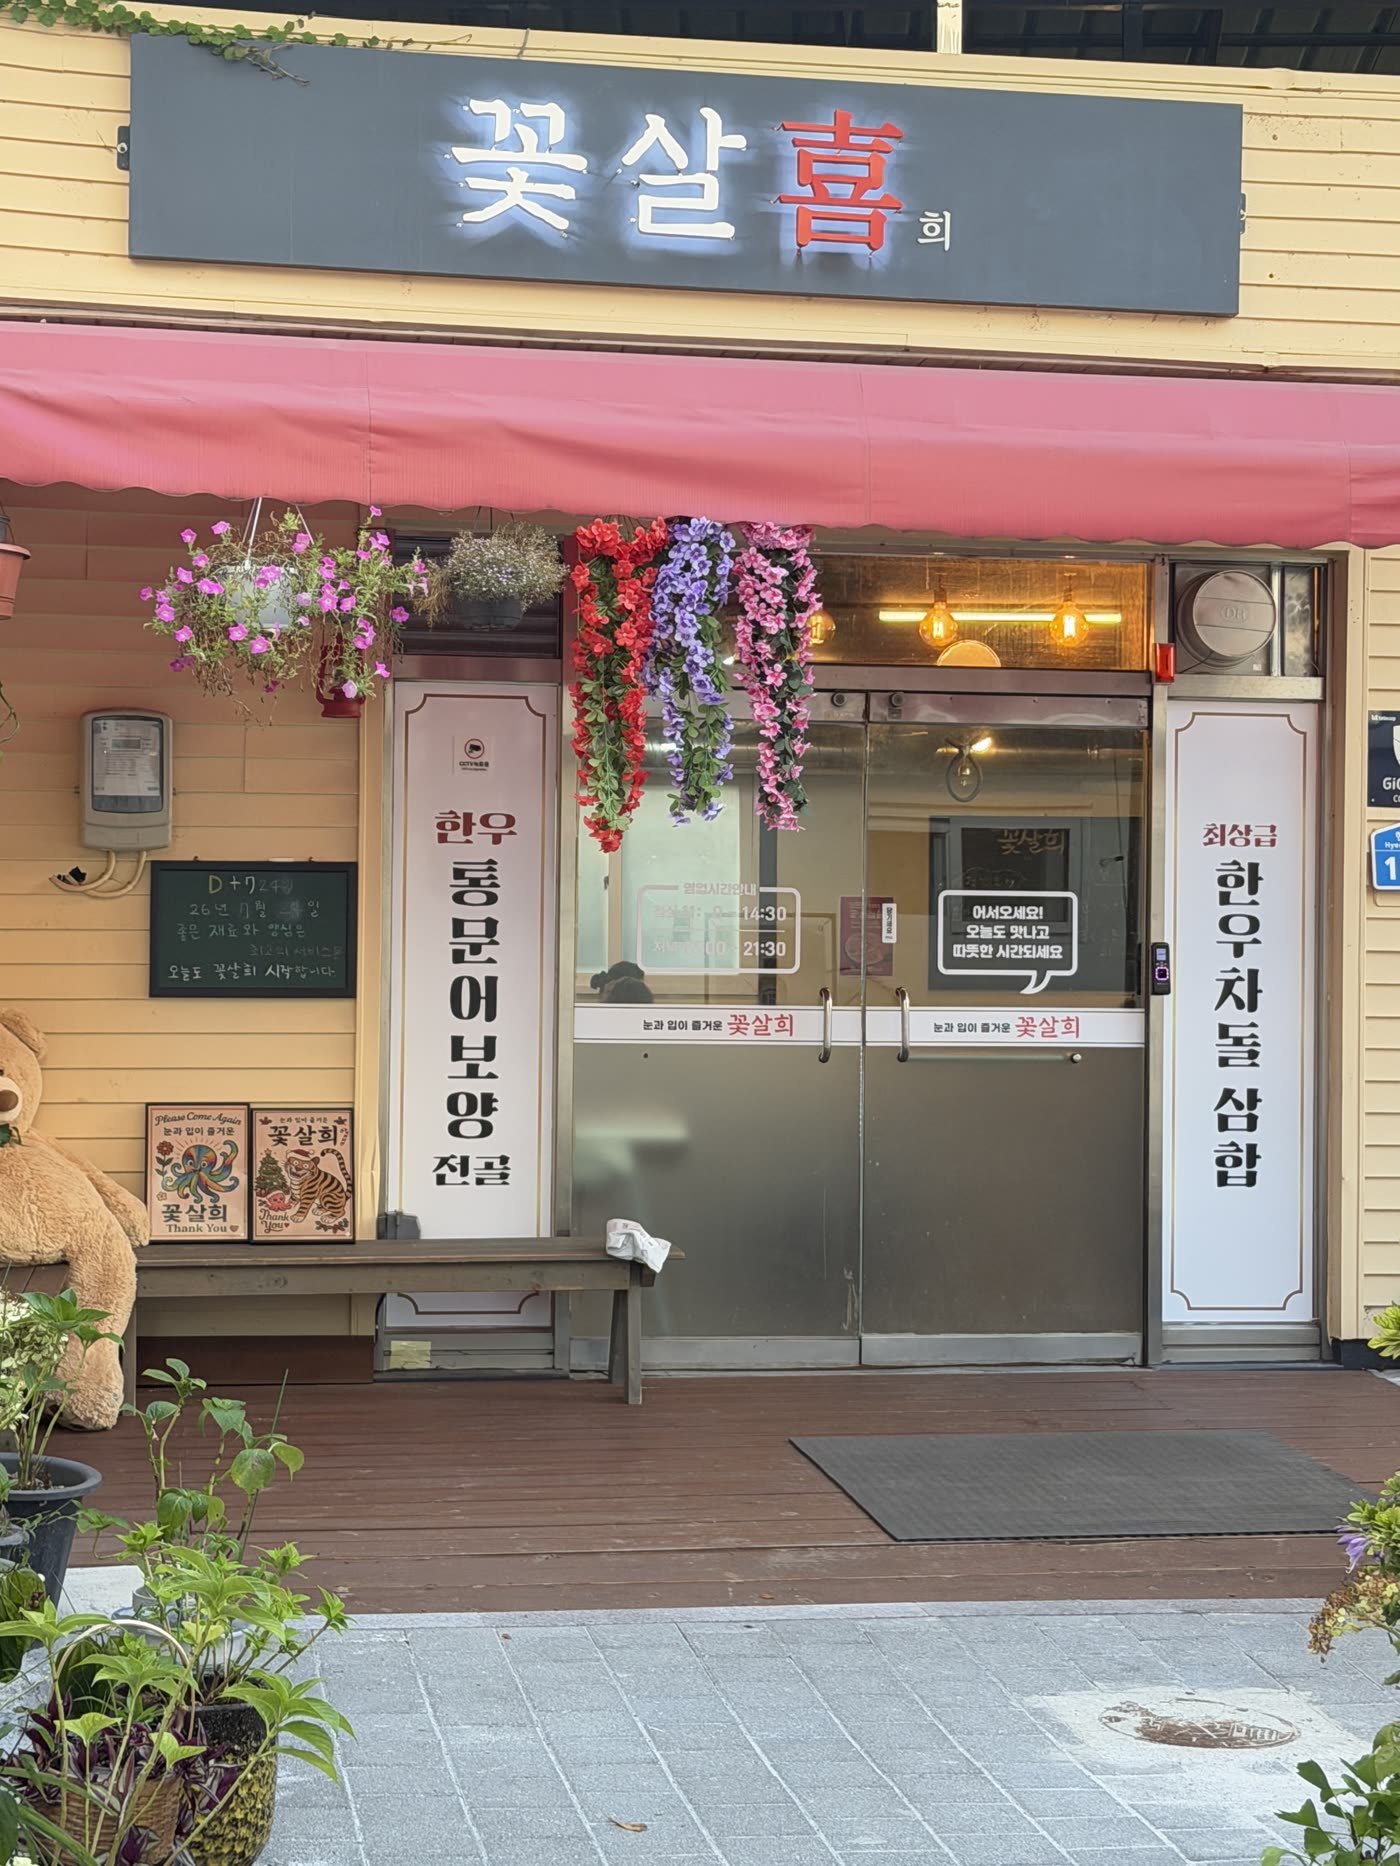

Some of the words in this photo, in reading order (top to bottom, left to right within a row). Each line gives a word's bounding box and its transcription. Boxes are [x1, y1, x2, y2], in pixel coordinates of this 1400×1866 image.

[434, 809, 518, 846] 한우
[1202, 822, 1278, 849] 최상급
[683, 882, 757, 897] 영업시간안내
[741, 905, 787, 922] 14:30
[972, 904, 1044, 920] 어서오세요!
[965, 924, 1007, 939] 오늘도
[1009, 924, 1051, 940] 맛나고
[742, 941, 787, 957] 21:30
[952, 943, 994, 959] 따뜻한
[996, 944, 1064, 960] 시간되세요
[167, 964, 203, 982] 오늘도
[642, 1019, 664, 1031] 눈과
[667, 1019, 688, 1031] 입이
[691, 1019, 723, 1032] 즐거운
[727, 1013, 794, 1037] 꽃살희
[933, 1022, 954, 1033] 눈과
[957, 1022, 977, 1033] 입이
[980, 1022, 1011, 1034] 즐거운
[1015, 1016, 1080, 1039] 꽃살희
[154, 1114, 185, 1126] Please
[187, 1111, 212, 1121] Come
[213, 1113, 242, 1125] Again
[163, 1126, 182, 1136] 눈과
[185, 1126, 204, 1136] 입이
[268, 1124, 338, 1147] 꽃살희
[431, 1153, 513, 1187] 전골
[161, 1203, 228, 1223] 꽃살희
[258, 1208, 291, 1222] Thank
[166, 1223, 203, 1233] Thank
[206, 1223, 228, 1233] You
[260, 1220, 286, 1234] You
